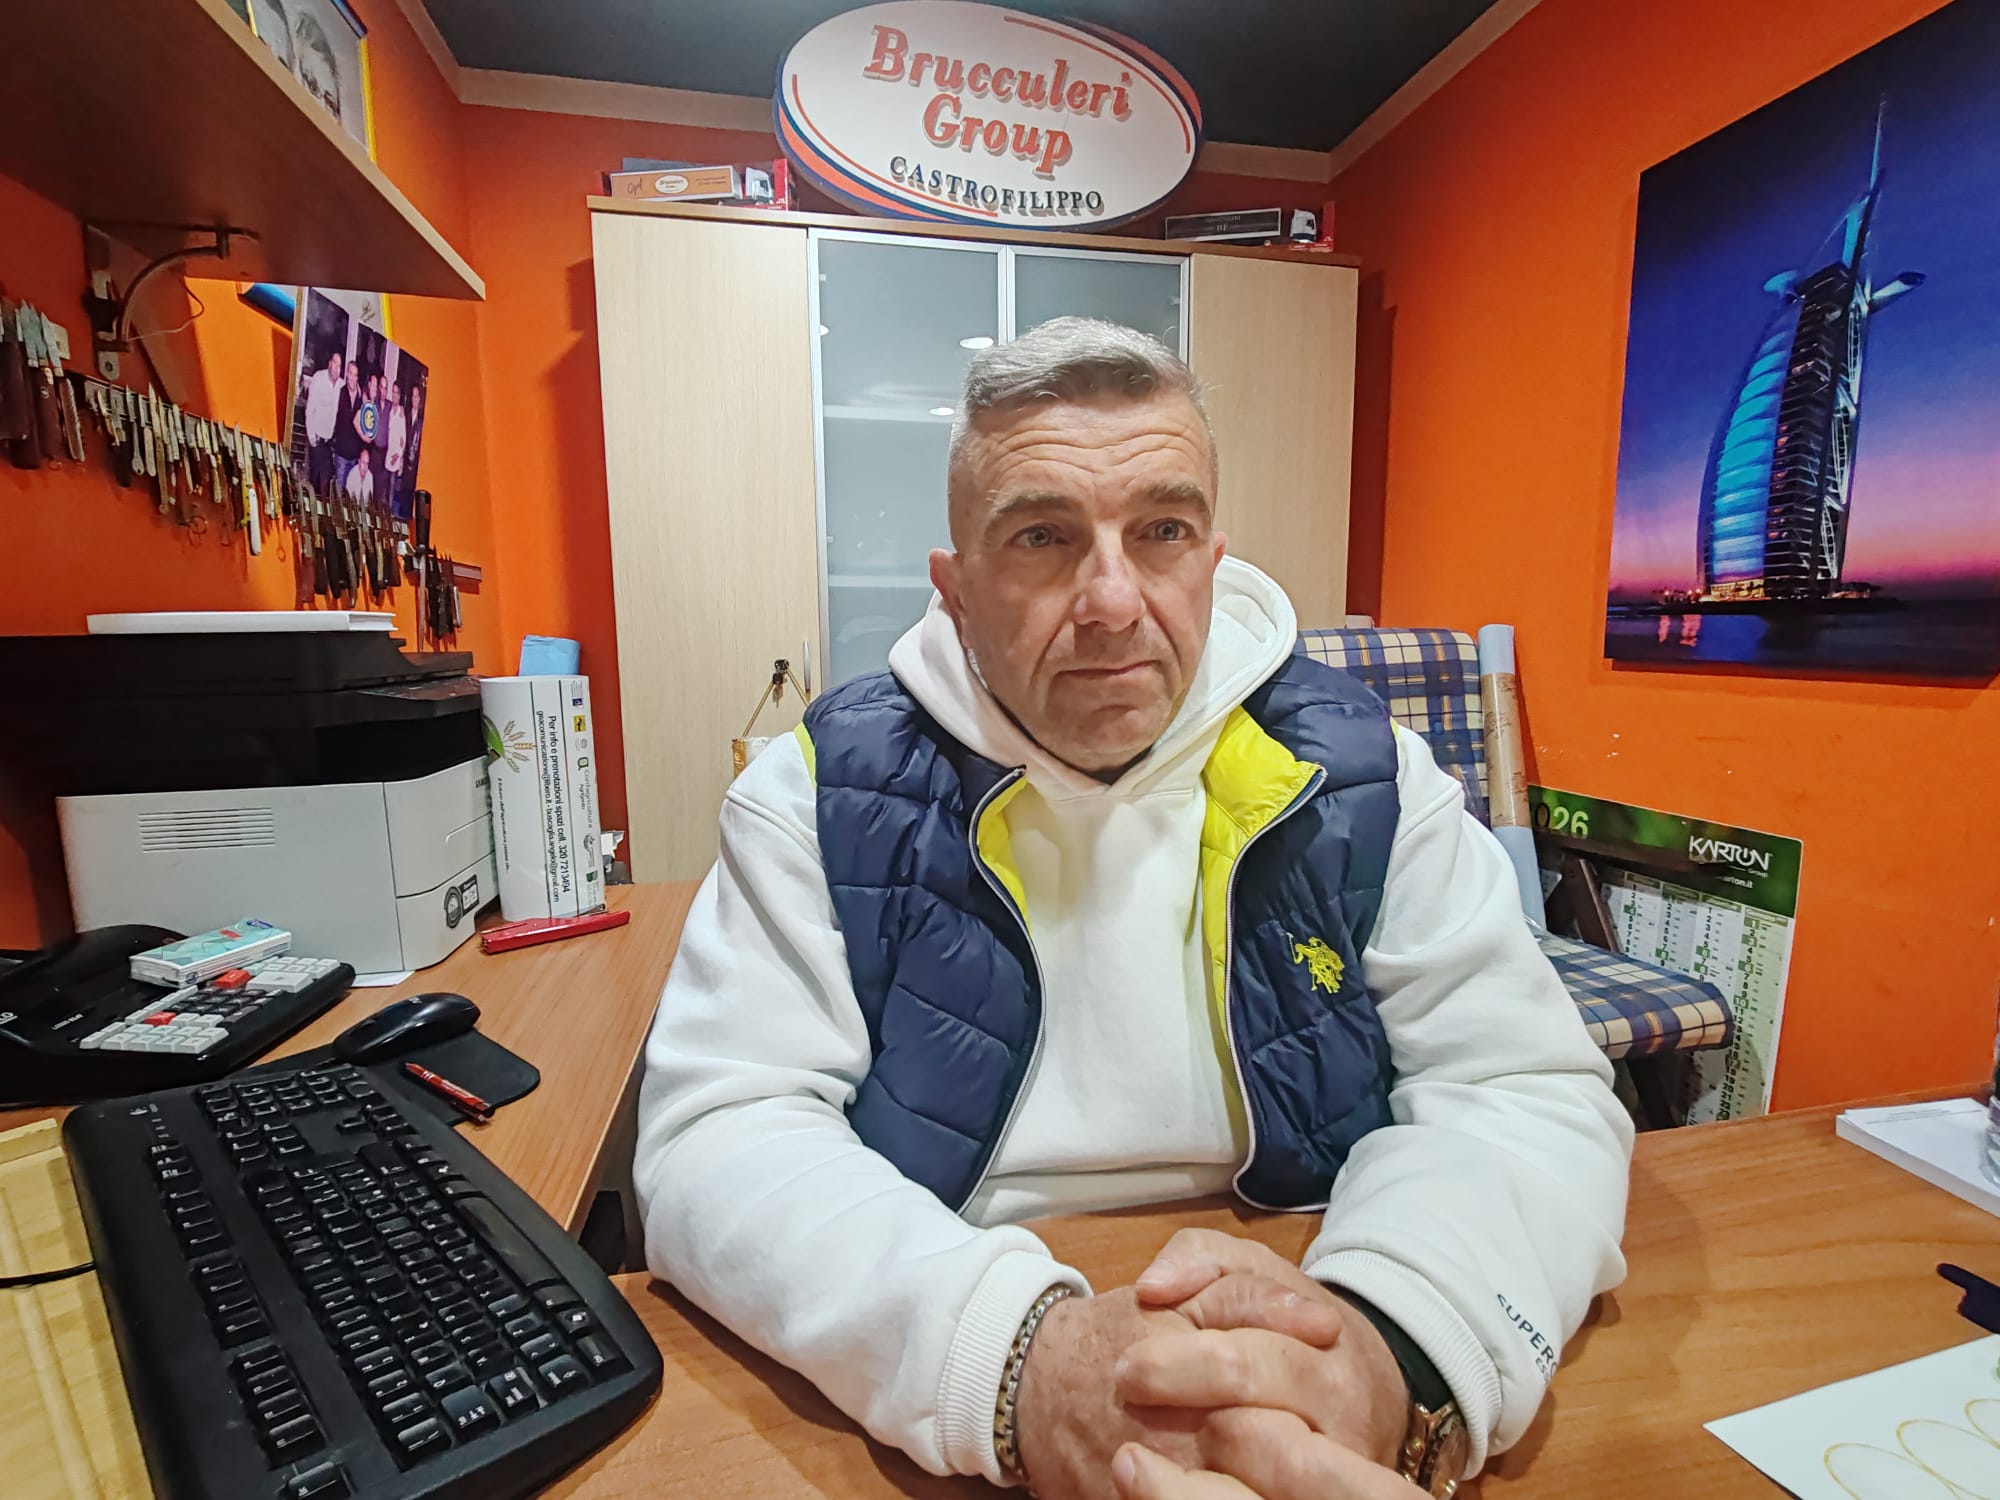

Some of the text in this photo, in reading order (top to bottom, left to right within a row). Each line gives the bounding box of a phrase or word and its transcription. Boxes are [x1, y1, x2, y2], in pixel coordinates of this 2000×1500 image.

[864, 25, 1133, 119] Brucculeri
[923, 93, 1073, 178] Group
[890, 156, 1104, 216] CASTROFILIPPO
[548, 716, 557, 730] Per
[549, 731, 559, 747] info
[549, 756, 563, 804] prenotazioni
[555, 806, 566, 826] spazi
[558, 845, 568, 859] 320
[1689, 835, 1771, 870] KARTON
